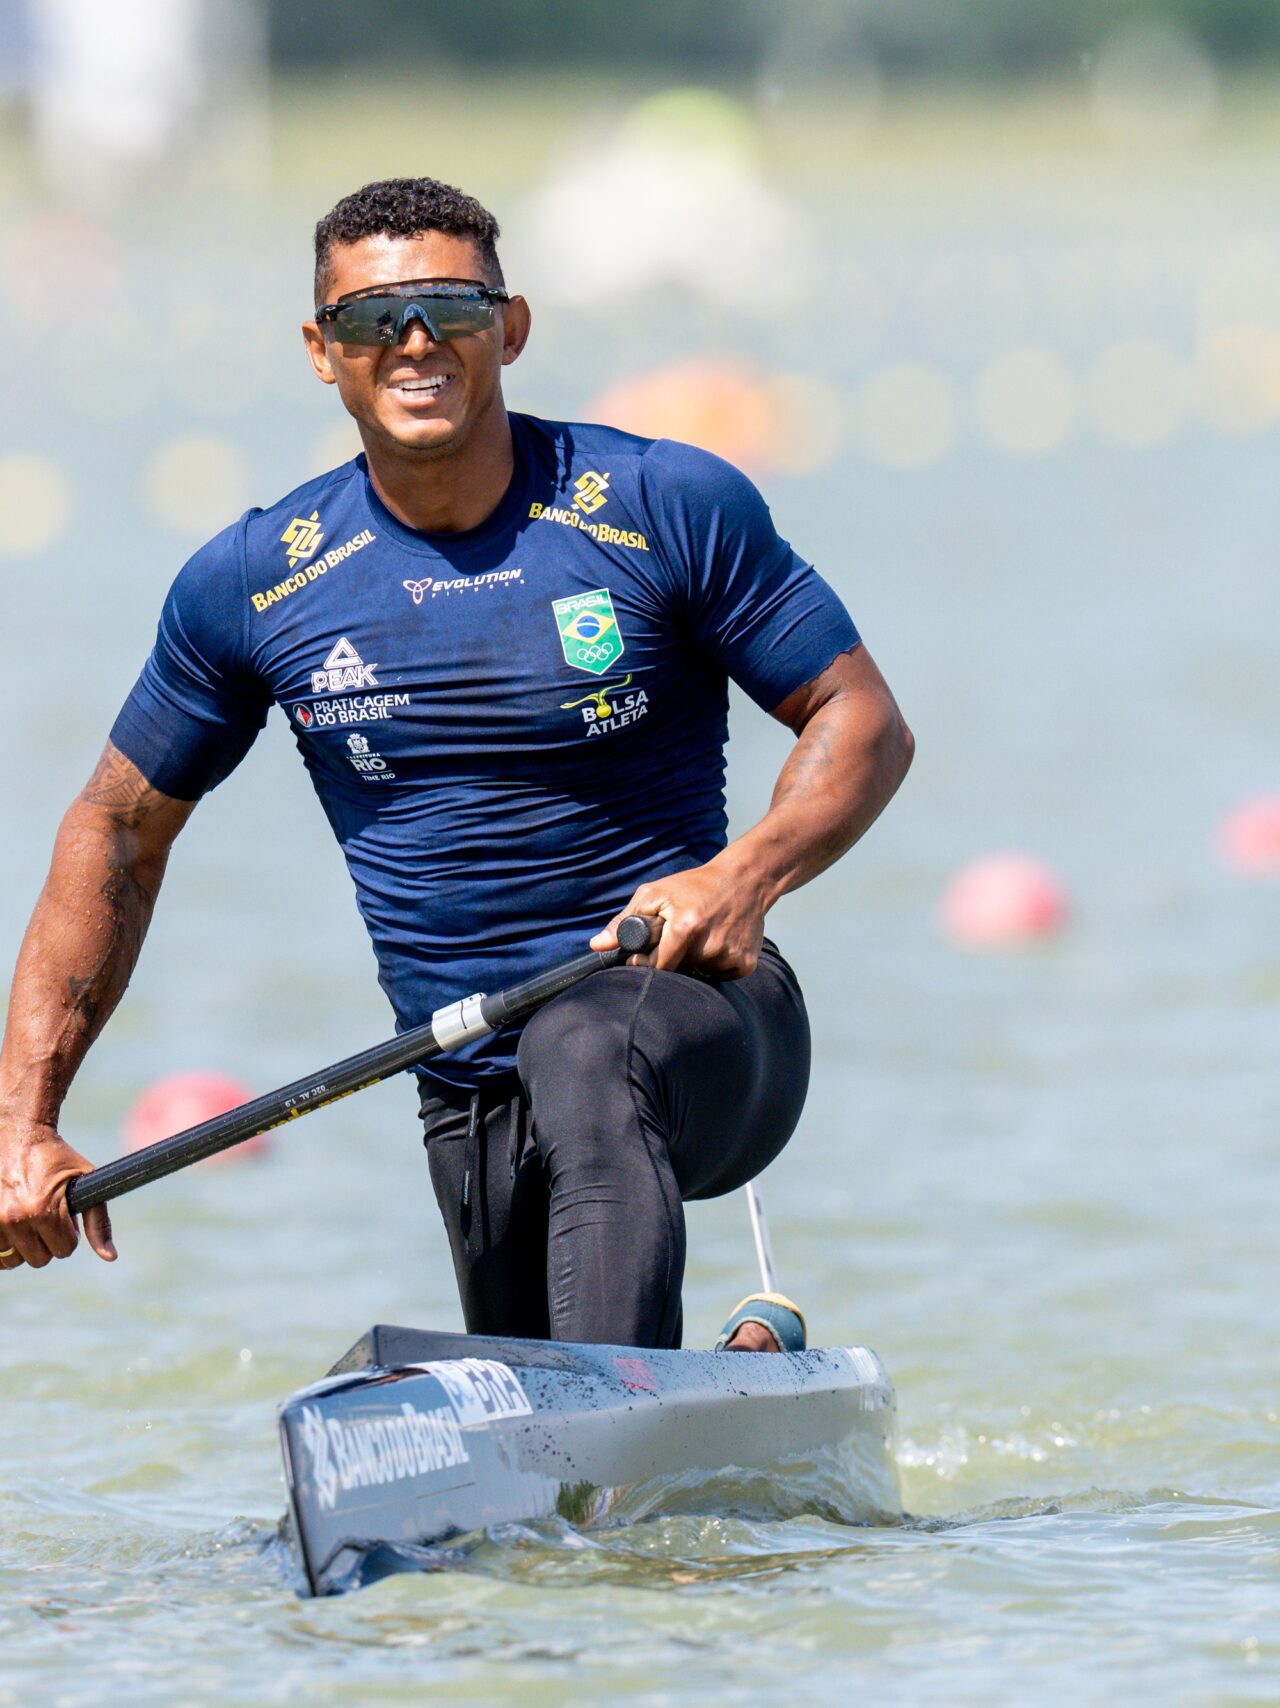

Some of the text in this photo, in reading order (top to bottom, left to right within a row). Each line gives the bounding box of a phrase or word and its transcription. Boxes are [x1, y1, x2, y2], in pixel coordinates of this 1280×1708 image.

[528, 502, 580, 527] BANCO
[597, 523, 650, 551] BRASIL
[251, 529, 376, 612] BANCO DO BRASIL
[432, 568, 522, 591] EVOLUTION
[556, 594, 609, 615] BRASIL
[311, 663, 378, 693] PEAK
[313, 694, 410, 714] PRATICAGEM
[316, 707, 393, 726] DO BRASIL
[582, 690, 649, 723] BOLSA
[586, 704, 648, 737] ATLETA
[350, 758, 387, 771] RIO
[381, 773, 396, 781] RIO
[326, 1420, 395, 1490] BANCO
[401, 1403, 470, 1474] BRASIL
